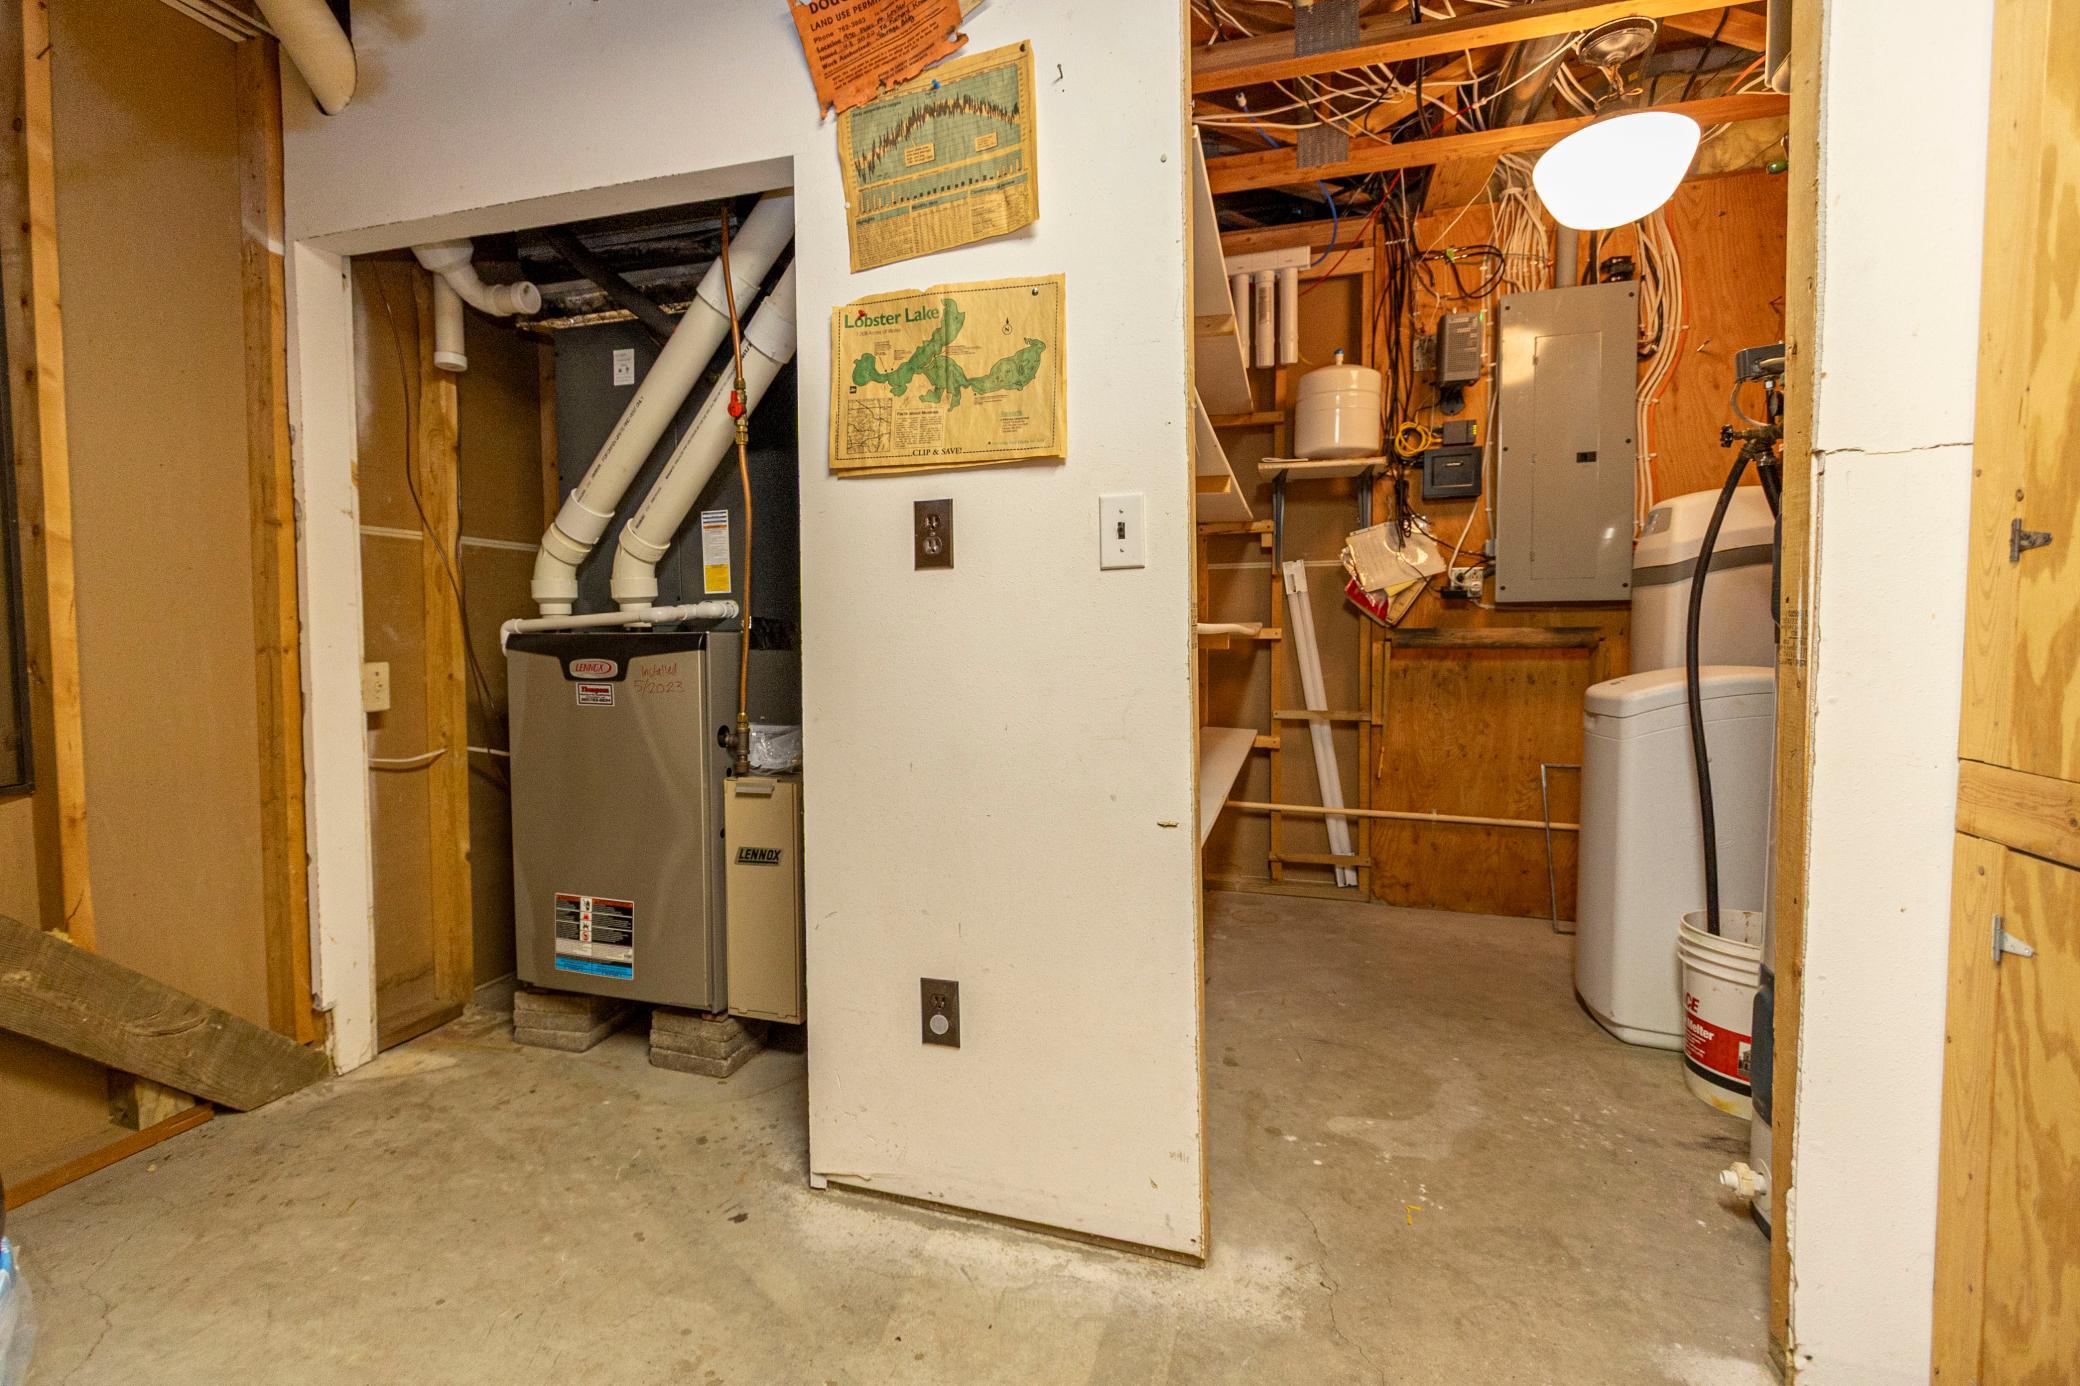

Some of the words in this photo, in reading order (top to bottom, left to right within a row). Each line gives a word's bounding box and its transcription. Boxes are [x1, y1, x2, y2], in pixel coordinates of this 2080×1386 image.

[809, 0, 848, 14] DOU
[810, 16, 833, 31] LAND
[835, 9, 851, 21] USE
[852, 0, 881, 14] PERM
[844, 312, 901, 329] Lobster
[905, 305, 940, 323] Lake
[912, 449, 930, 457] CLIP
[941, 447, 963, 455] SAVE!
[575, 663, 604, 673] LENNOX
[641, 663, 678, 677] Installed
[738, 848, 781, 861] LENNOX
[1685, 991, 1700, 1013] CE
